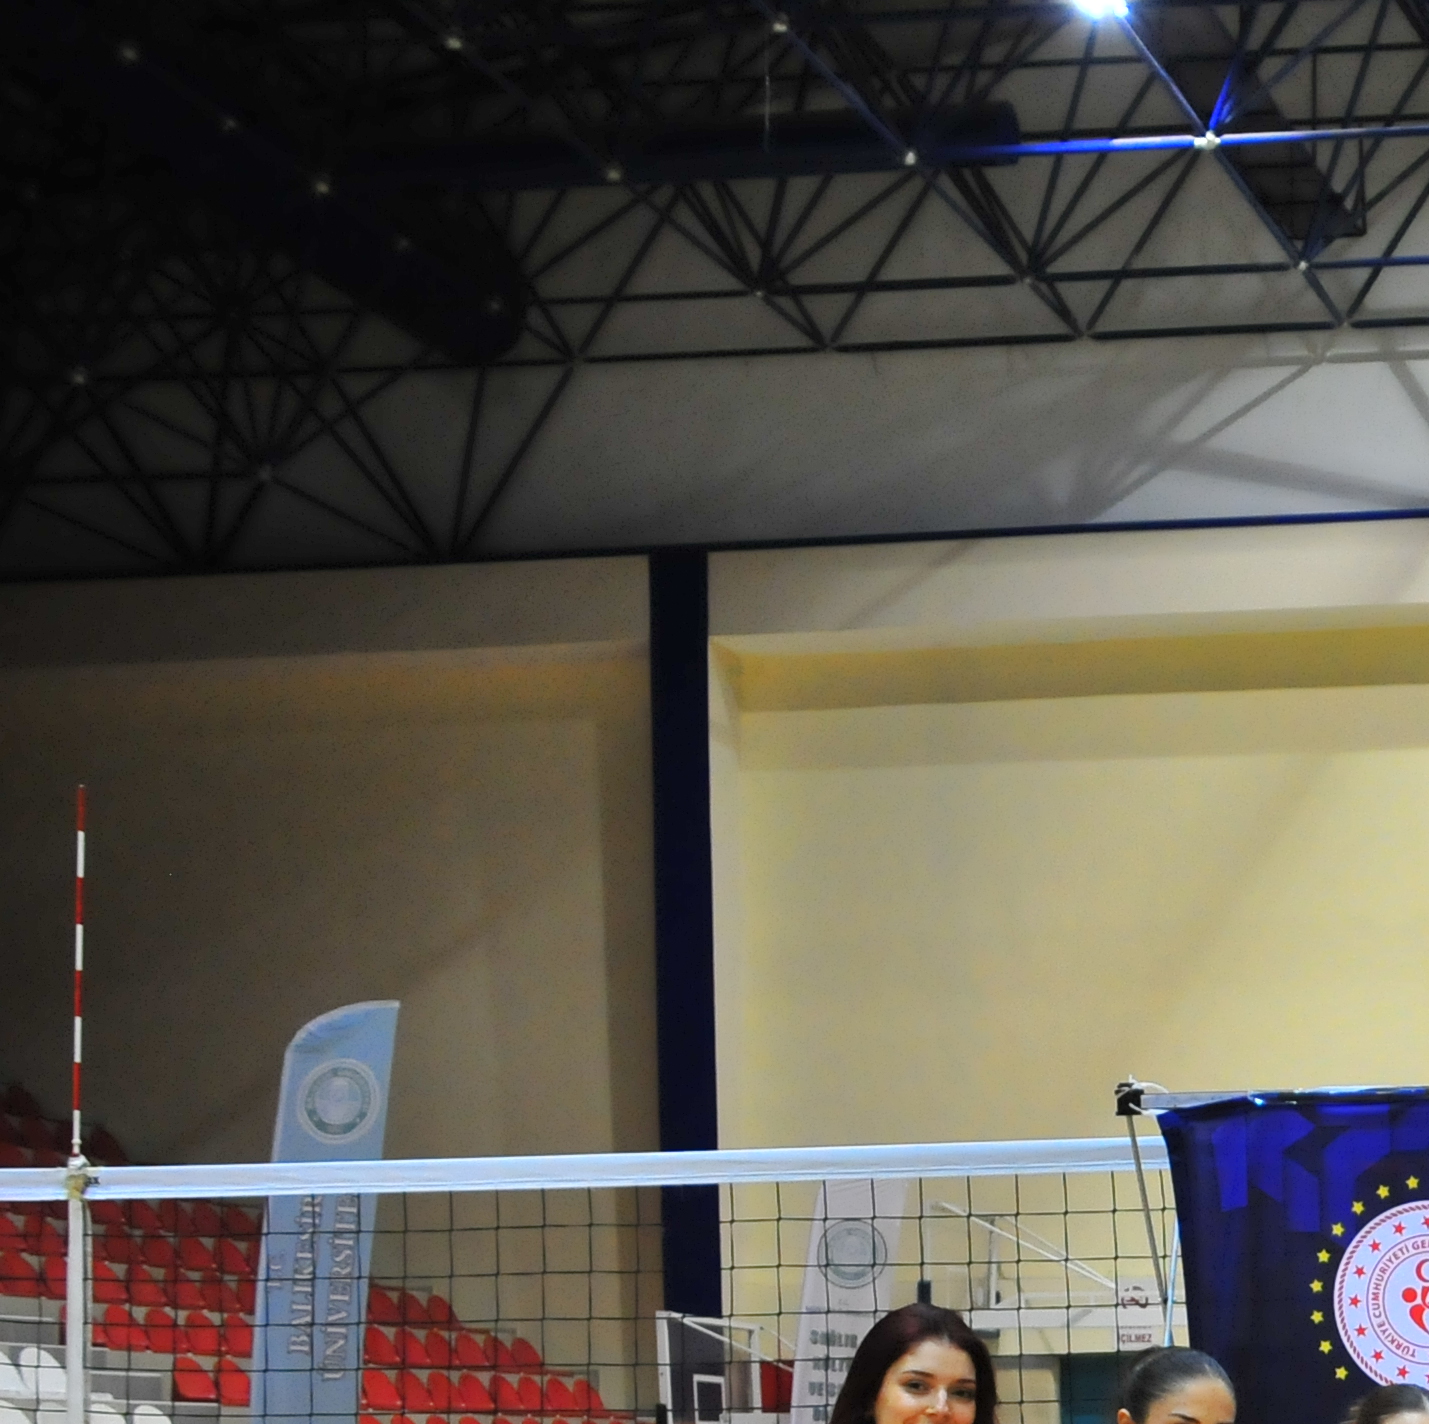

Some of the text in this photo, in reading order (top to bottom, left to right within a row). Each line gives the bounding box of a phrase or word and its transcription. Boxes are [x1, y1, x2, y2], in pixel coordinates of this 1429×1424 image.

[317, 1194, 359, 1382] ÜNİVERSİTE
[1371, 1244, 1410, 1317] CUMHURİYETİ
[1376, 1316, 1416, 1358] TÜRKİYE
